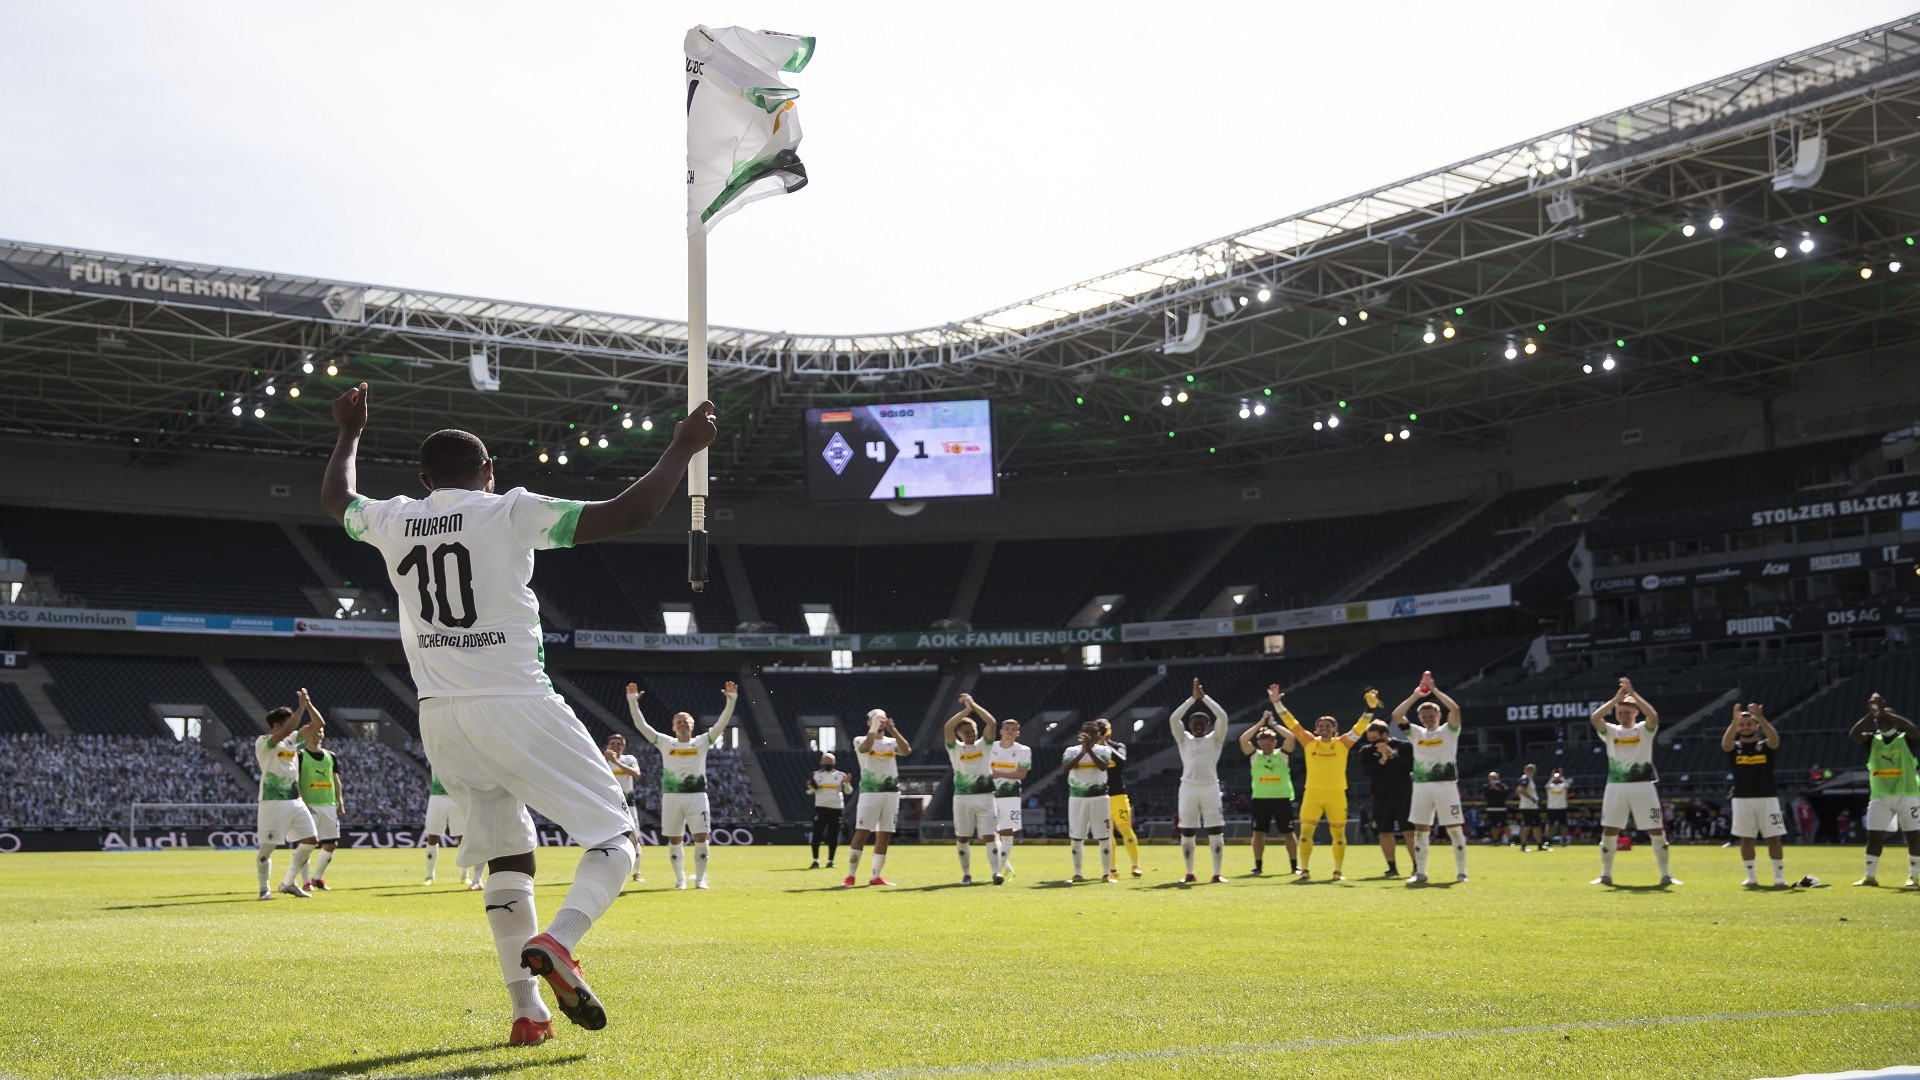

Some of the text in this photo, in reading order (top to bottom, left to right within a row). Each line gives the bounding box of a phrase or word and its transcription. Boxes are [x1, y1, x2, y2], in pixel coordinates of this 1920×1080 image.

[69, 262, 262, 302] FÜR TOLERANZ
[865, 441, 886, 463] 4
[914, 441, 928, 459] 1
[1751, 490, 1920, 527] STOLZER BLICK Z
[404, 513, 463, 537] THURAM
[397, 541, 478, 629] 10
[35, 611, 127, 625] Aluminium
[1726, 616, 1774, 635] PUMA
[1827, 608, 1881, 625] DIS AG
[576, 632, 634, 644] RP ONLINE
[644, 634, 705, 646] RP ONLINE
[916, 627, 1114, 648] AOK-FAMILIENBLOCK
[1507, 704, 1539, 721] DIE
[103, 831, 189, 848] Audi
